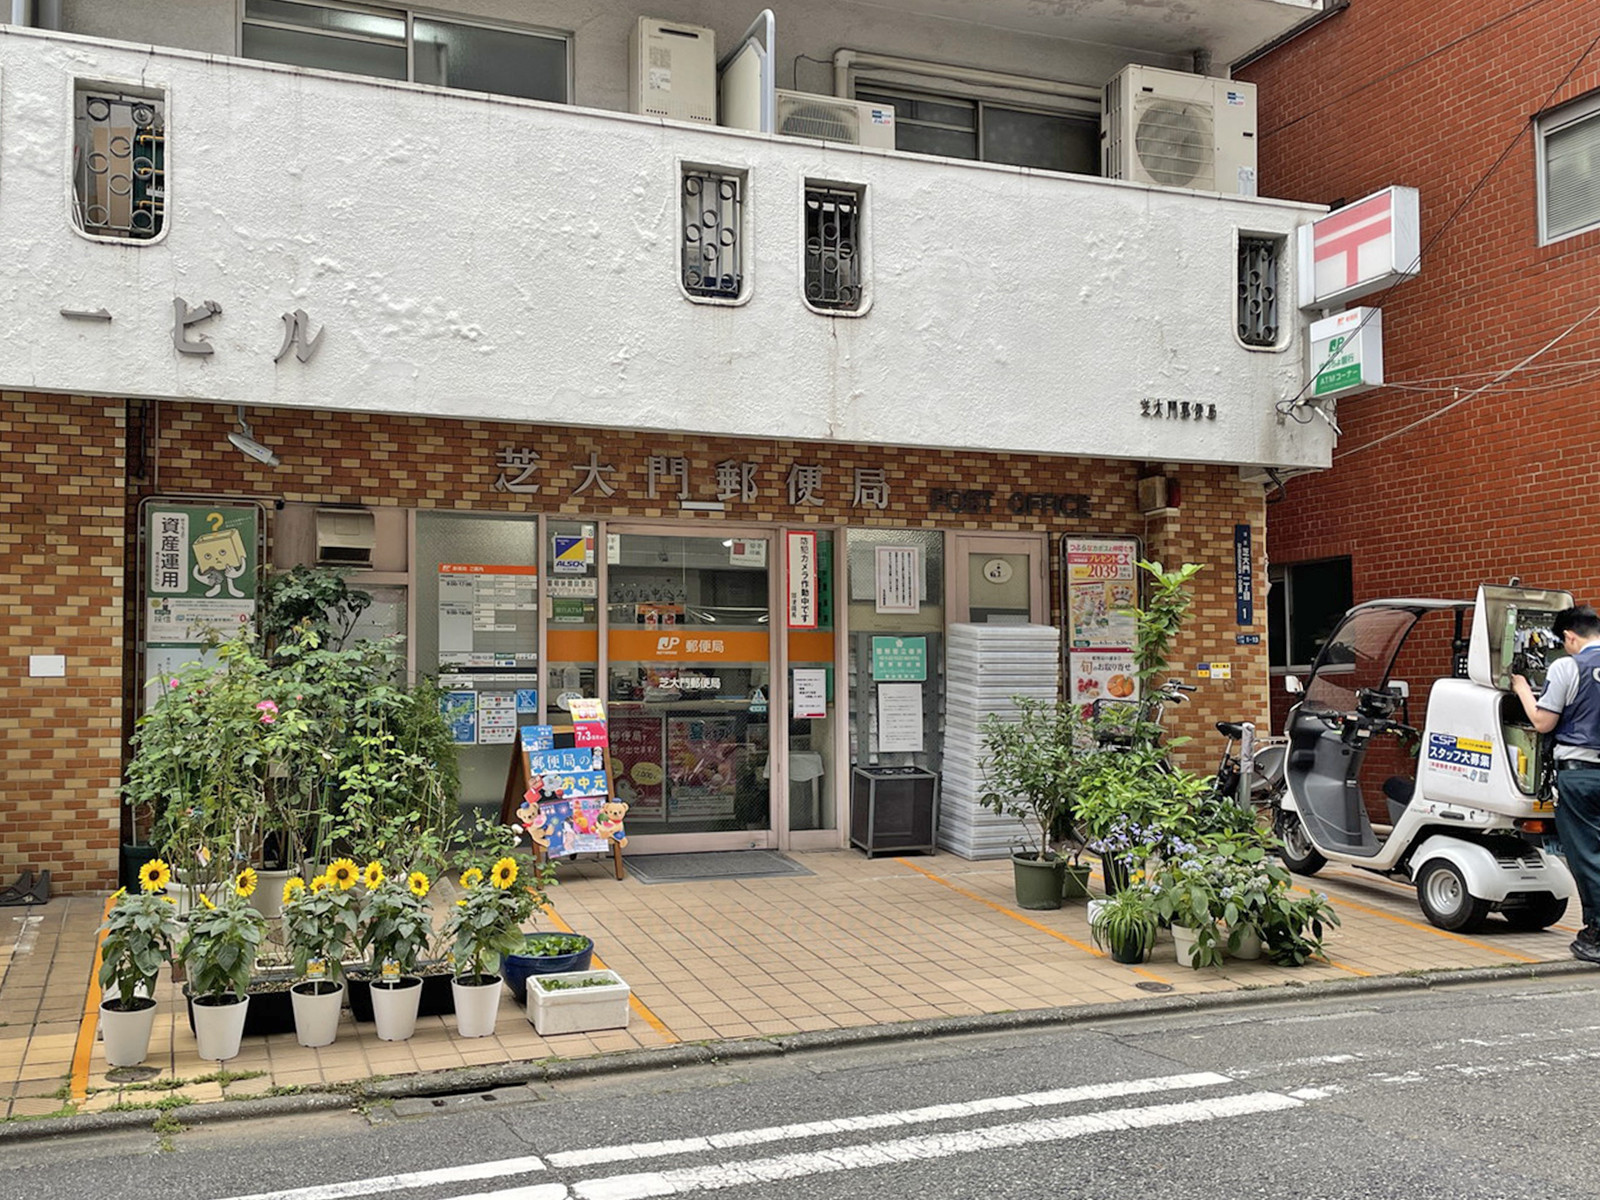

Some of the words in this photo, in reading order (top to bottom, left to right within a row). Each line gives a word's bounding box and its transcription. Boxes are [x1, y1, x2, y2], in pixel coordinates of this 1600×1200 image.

[1320, 369, 1358, 384] ATMコーナー
[494, 446, 891, 510] 芝大門郵便局
[930, 488, 995, 513] POST
[1007, 491, 1092, 518] OFFICE
[161, 517, 180, 588] 資産運用
[555, 560, 585, 568] ALSOK
[1087, 564, 1119, 578] 2039
[657, 636, 681, 650] JP
[686, 640, 724, 654] 郵便局
[659, 677, 722, 690] 芝大門郵便局
[1430, 733, 1457, 746] CSP
[531, 753, 591, 771] 郵便局の
[1429, 746, 1490, 768] スタッフ大募集
[561, 774, 606, 791] お中元
